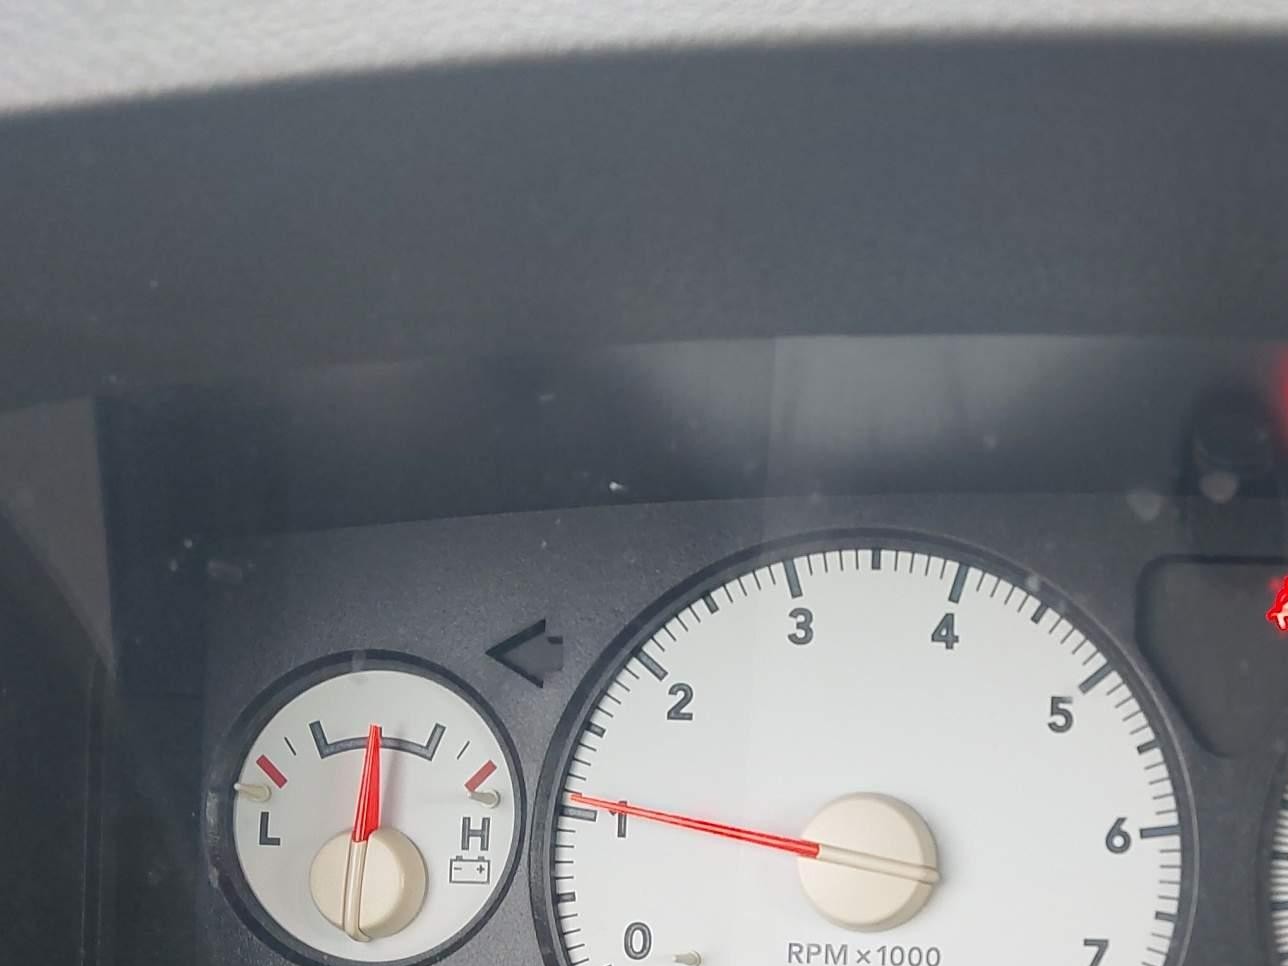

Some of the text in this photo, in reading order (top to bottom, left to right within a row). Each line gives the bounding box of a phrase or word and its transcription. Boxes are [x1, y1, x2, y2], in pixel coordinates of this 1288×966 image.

[787, 607, 814, 646] 3
[930, 612, 960, 650] 4
[666, 682, 694, 721] 2
[1047, 695, 1074, 734] 5
[258, 811, 281, 846] L
[460, 816, 491, 852] H
[1105, 817, 1132, 855] 6
[623, 921, 652, 961] 0
[787, 942, 848, 966] RPM
